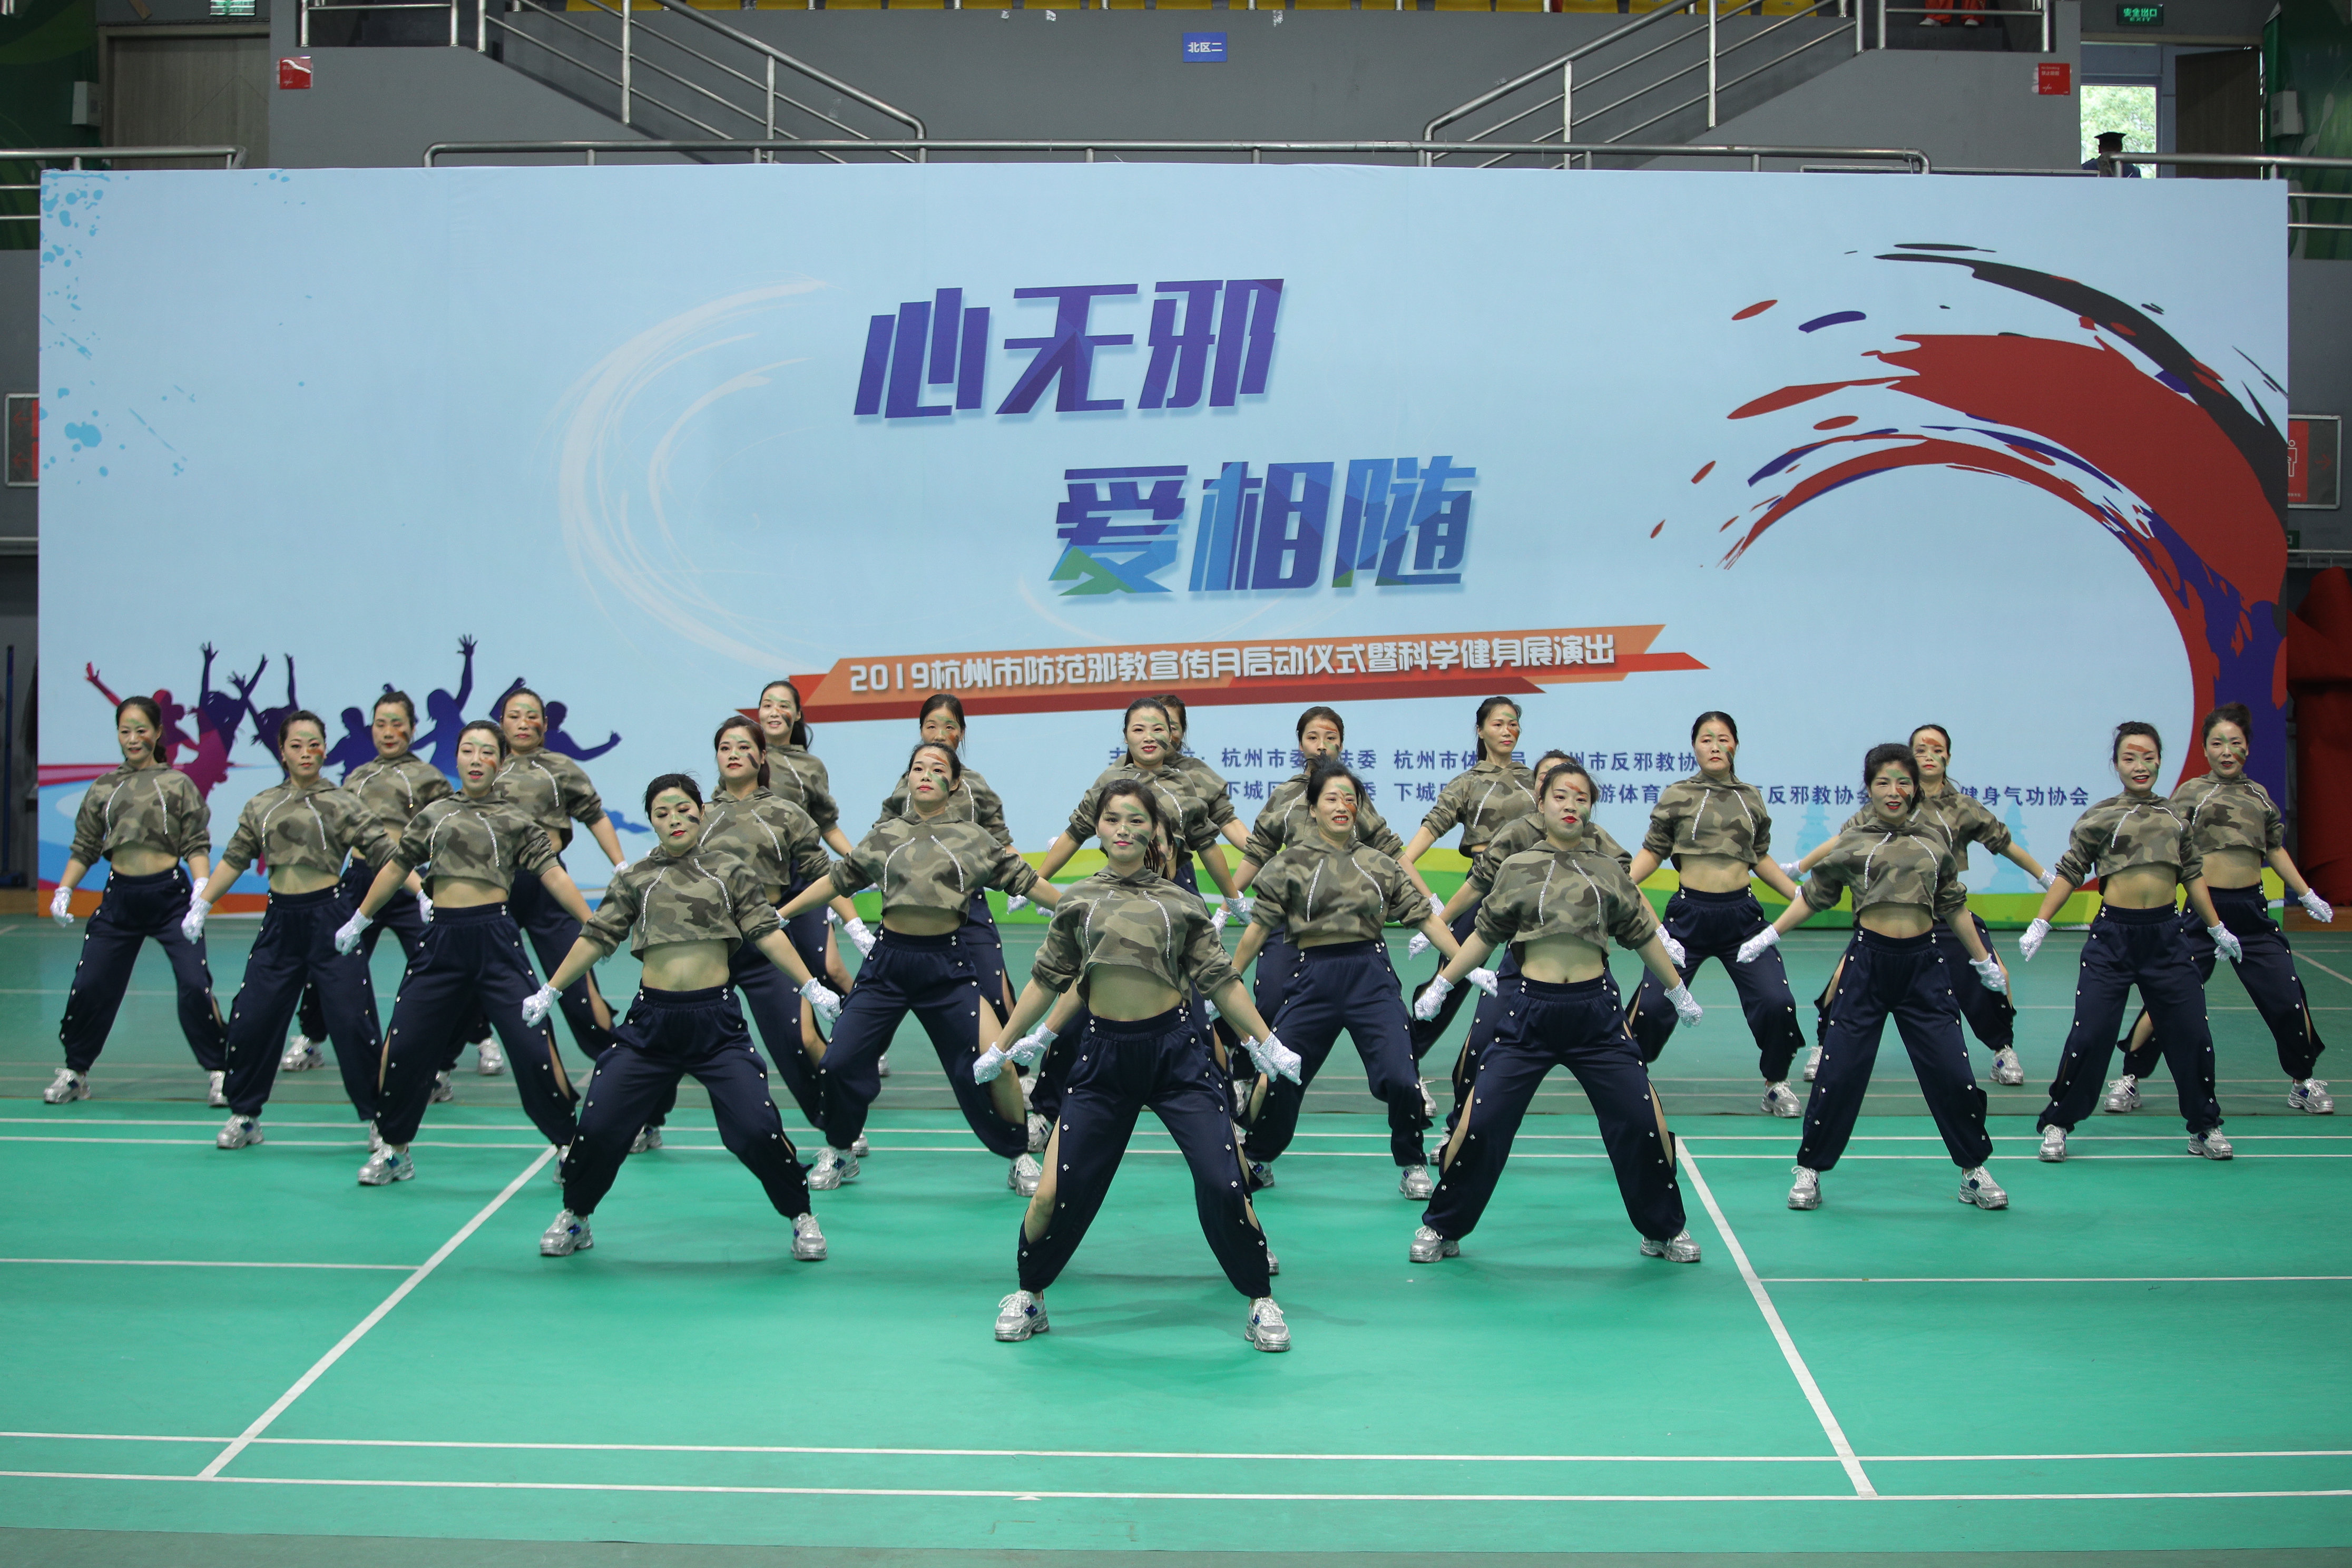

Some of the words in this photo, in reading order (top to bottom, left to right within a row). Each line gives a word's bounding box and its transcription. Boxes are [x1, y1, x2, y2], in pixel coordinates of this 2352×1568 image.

[1188, 42, 1223, 53] 北区二
[2123, 7, 2157, 17] 安全出口
[854, 278, 1285, 419] 心无邪
[1047, 455, 1477, 596] 爱相随
